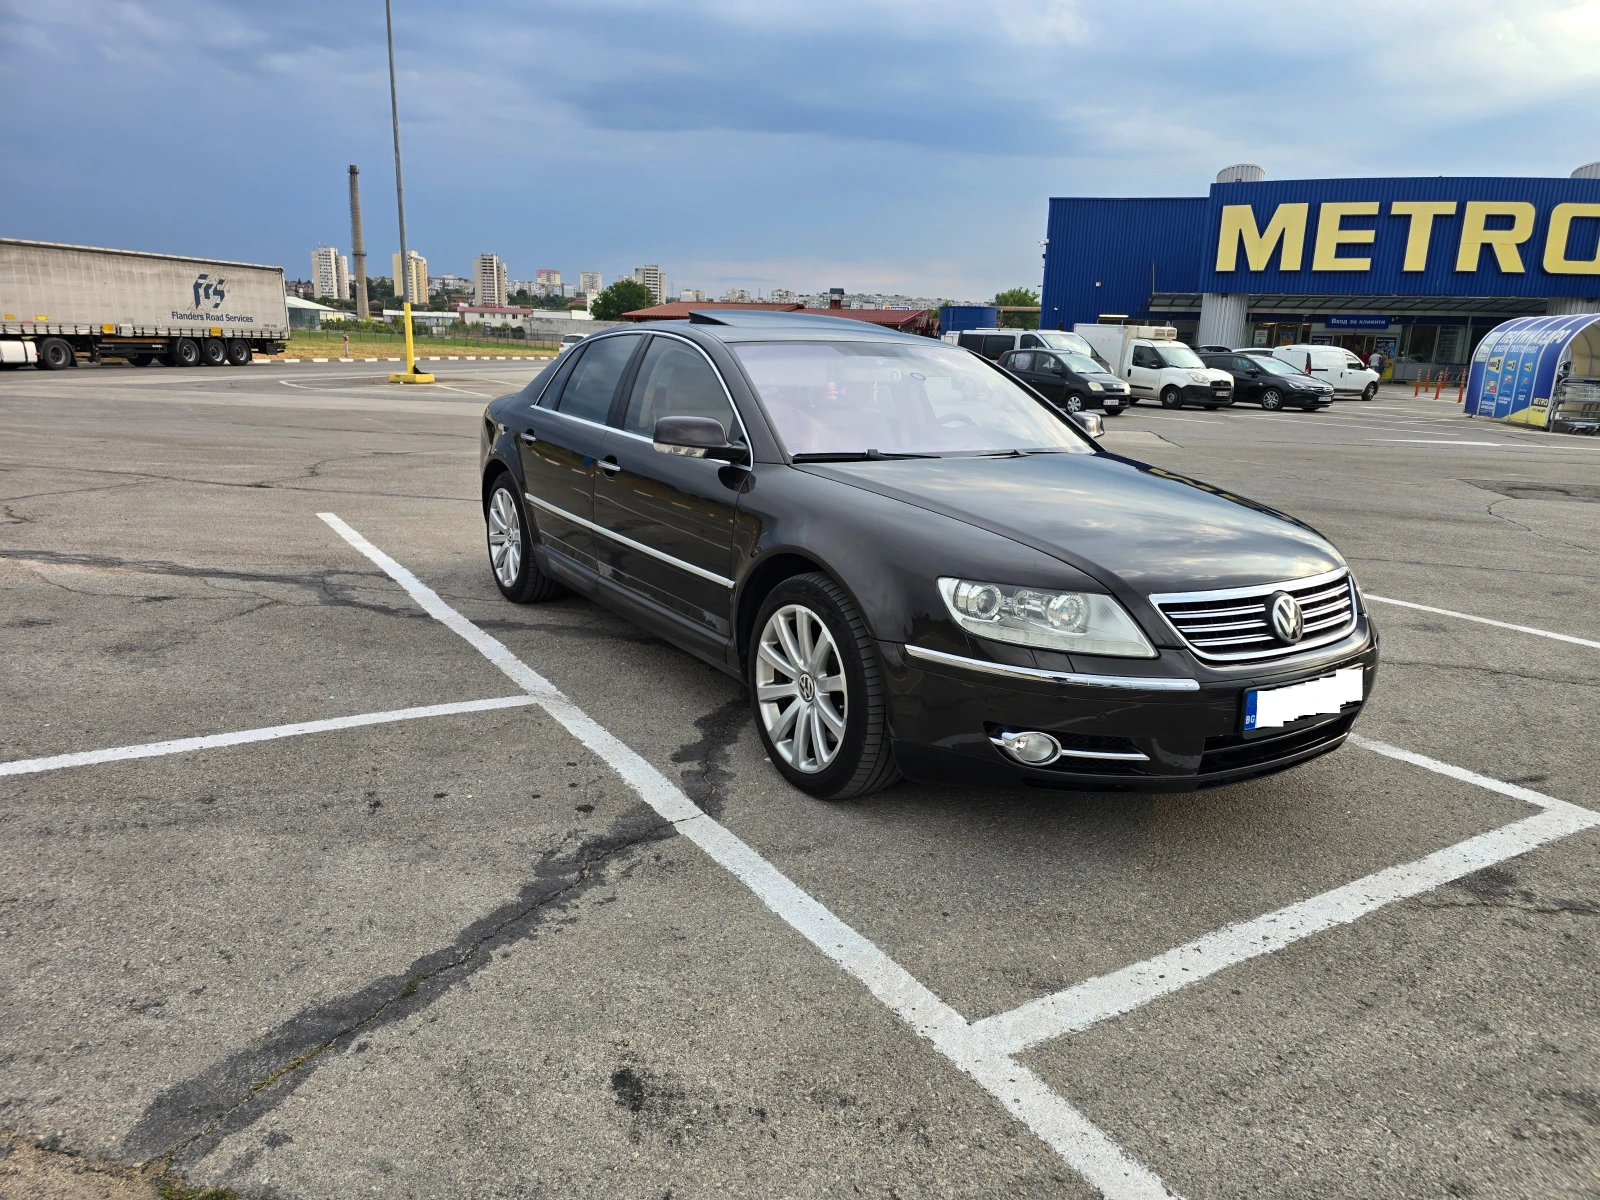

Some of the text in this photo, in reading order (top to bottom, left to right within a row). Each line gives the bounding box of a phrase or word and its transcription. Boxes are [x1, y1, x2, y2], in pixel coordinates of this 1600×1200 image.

[1215, 201, 1600, 274] METRO
[171, 311, 254, 323] Flanders Road Services
[1533, 397, 1549, 406] METRO
[1245, 715, 1256, 725] BG
